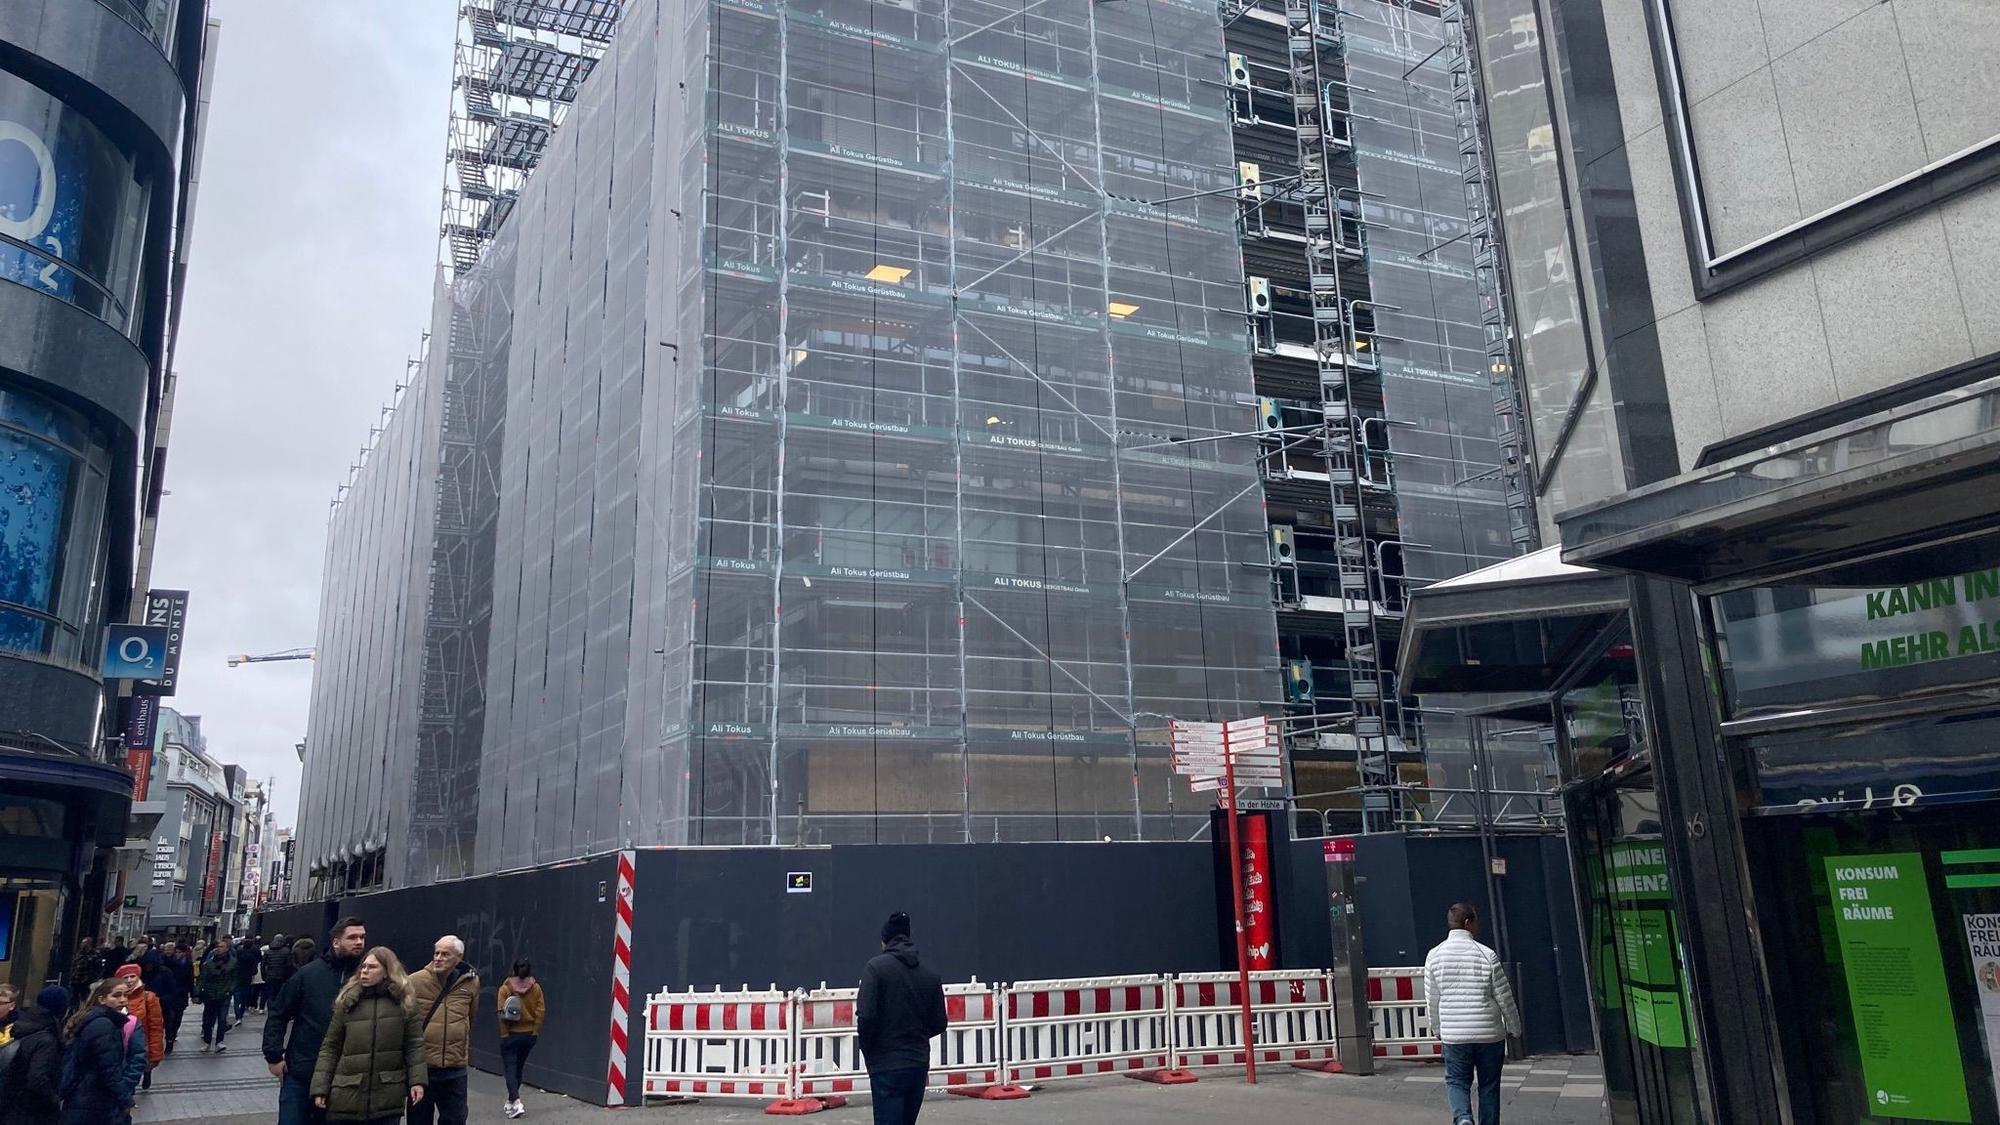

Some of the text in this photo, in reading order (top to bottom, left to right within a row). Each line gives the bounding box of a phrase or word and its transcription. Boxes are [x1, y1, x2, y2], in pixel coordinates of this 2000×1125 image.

[843, 23, 863, 35] Tokus
[977, 55, 991, 64] ALI
[993, 59, 1020, 71] TOKUS
[1142, 93, 1158, 103] Tokus
[717, 122, 769, 138] ALI TOKUS
[830, 146, 841, 154] Ali
[842, 148, 864, 160] Tokus
[992, 177, 1002, 185] Ali
[1004, 180, 1023, 190] Tokus
[1148, 208, 1165, 218] Tokus
[723, 260, 760, 273] Ali Tokus
[831, 280, 843, 289] Ali
[844, 282, 866, 292] Tokus
[1007, 306, 1028, 316] Tokus
[1147, 329, 1156, 337] Ali
[1157, 331, 1175, 340] Tokus
[1415, 368, 1438, 377] TOKUS
[721, 406, 759, 418] Ali Tokus
[831, 418, 908, 434] Ali Tokus Gerüstbau
[990, 435, 1004, 444] ALI
[1007, 437, 1036, 448] TOKUS
[716, 559, 756, 570] Ali Tokus
[831, 567, 910, 579] Ali Tokus Gerüstbau
[994, 577, 1009, 586] ALI
[1012, 578, 1042, 589] TOKUS
[1176, 591, 1195, 599] Tokus
[1867, 576, 1956, 620] KANN
[164, 599, 184, 687] DU MONDE
[1861, 630, 1949, 671] MEHR
[711, 725, 752, 734] Ali Tokus
[829, 727, 910, 737] Ali Tokus Gerüstbau
[1012, 731, 1085, 742] Ali Tokus Gerüstbau
[1239, 800, 1245, 808] In
[1247, 800, 1259, 808] der
[1836, 866, 1899, 881] KONSUM
[1840, 887, 1867, 901] FREI
[1843, 903, 1894, 921] RÄUME
